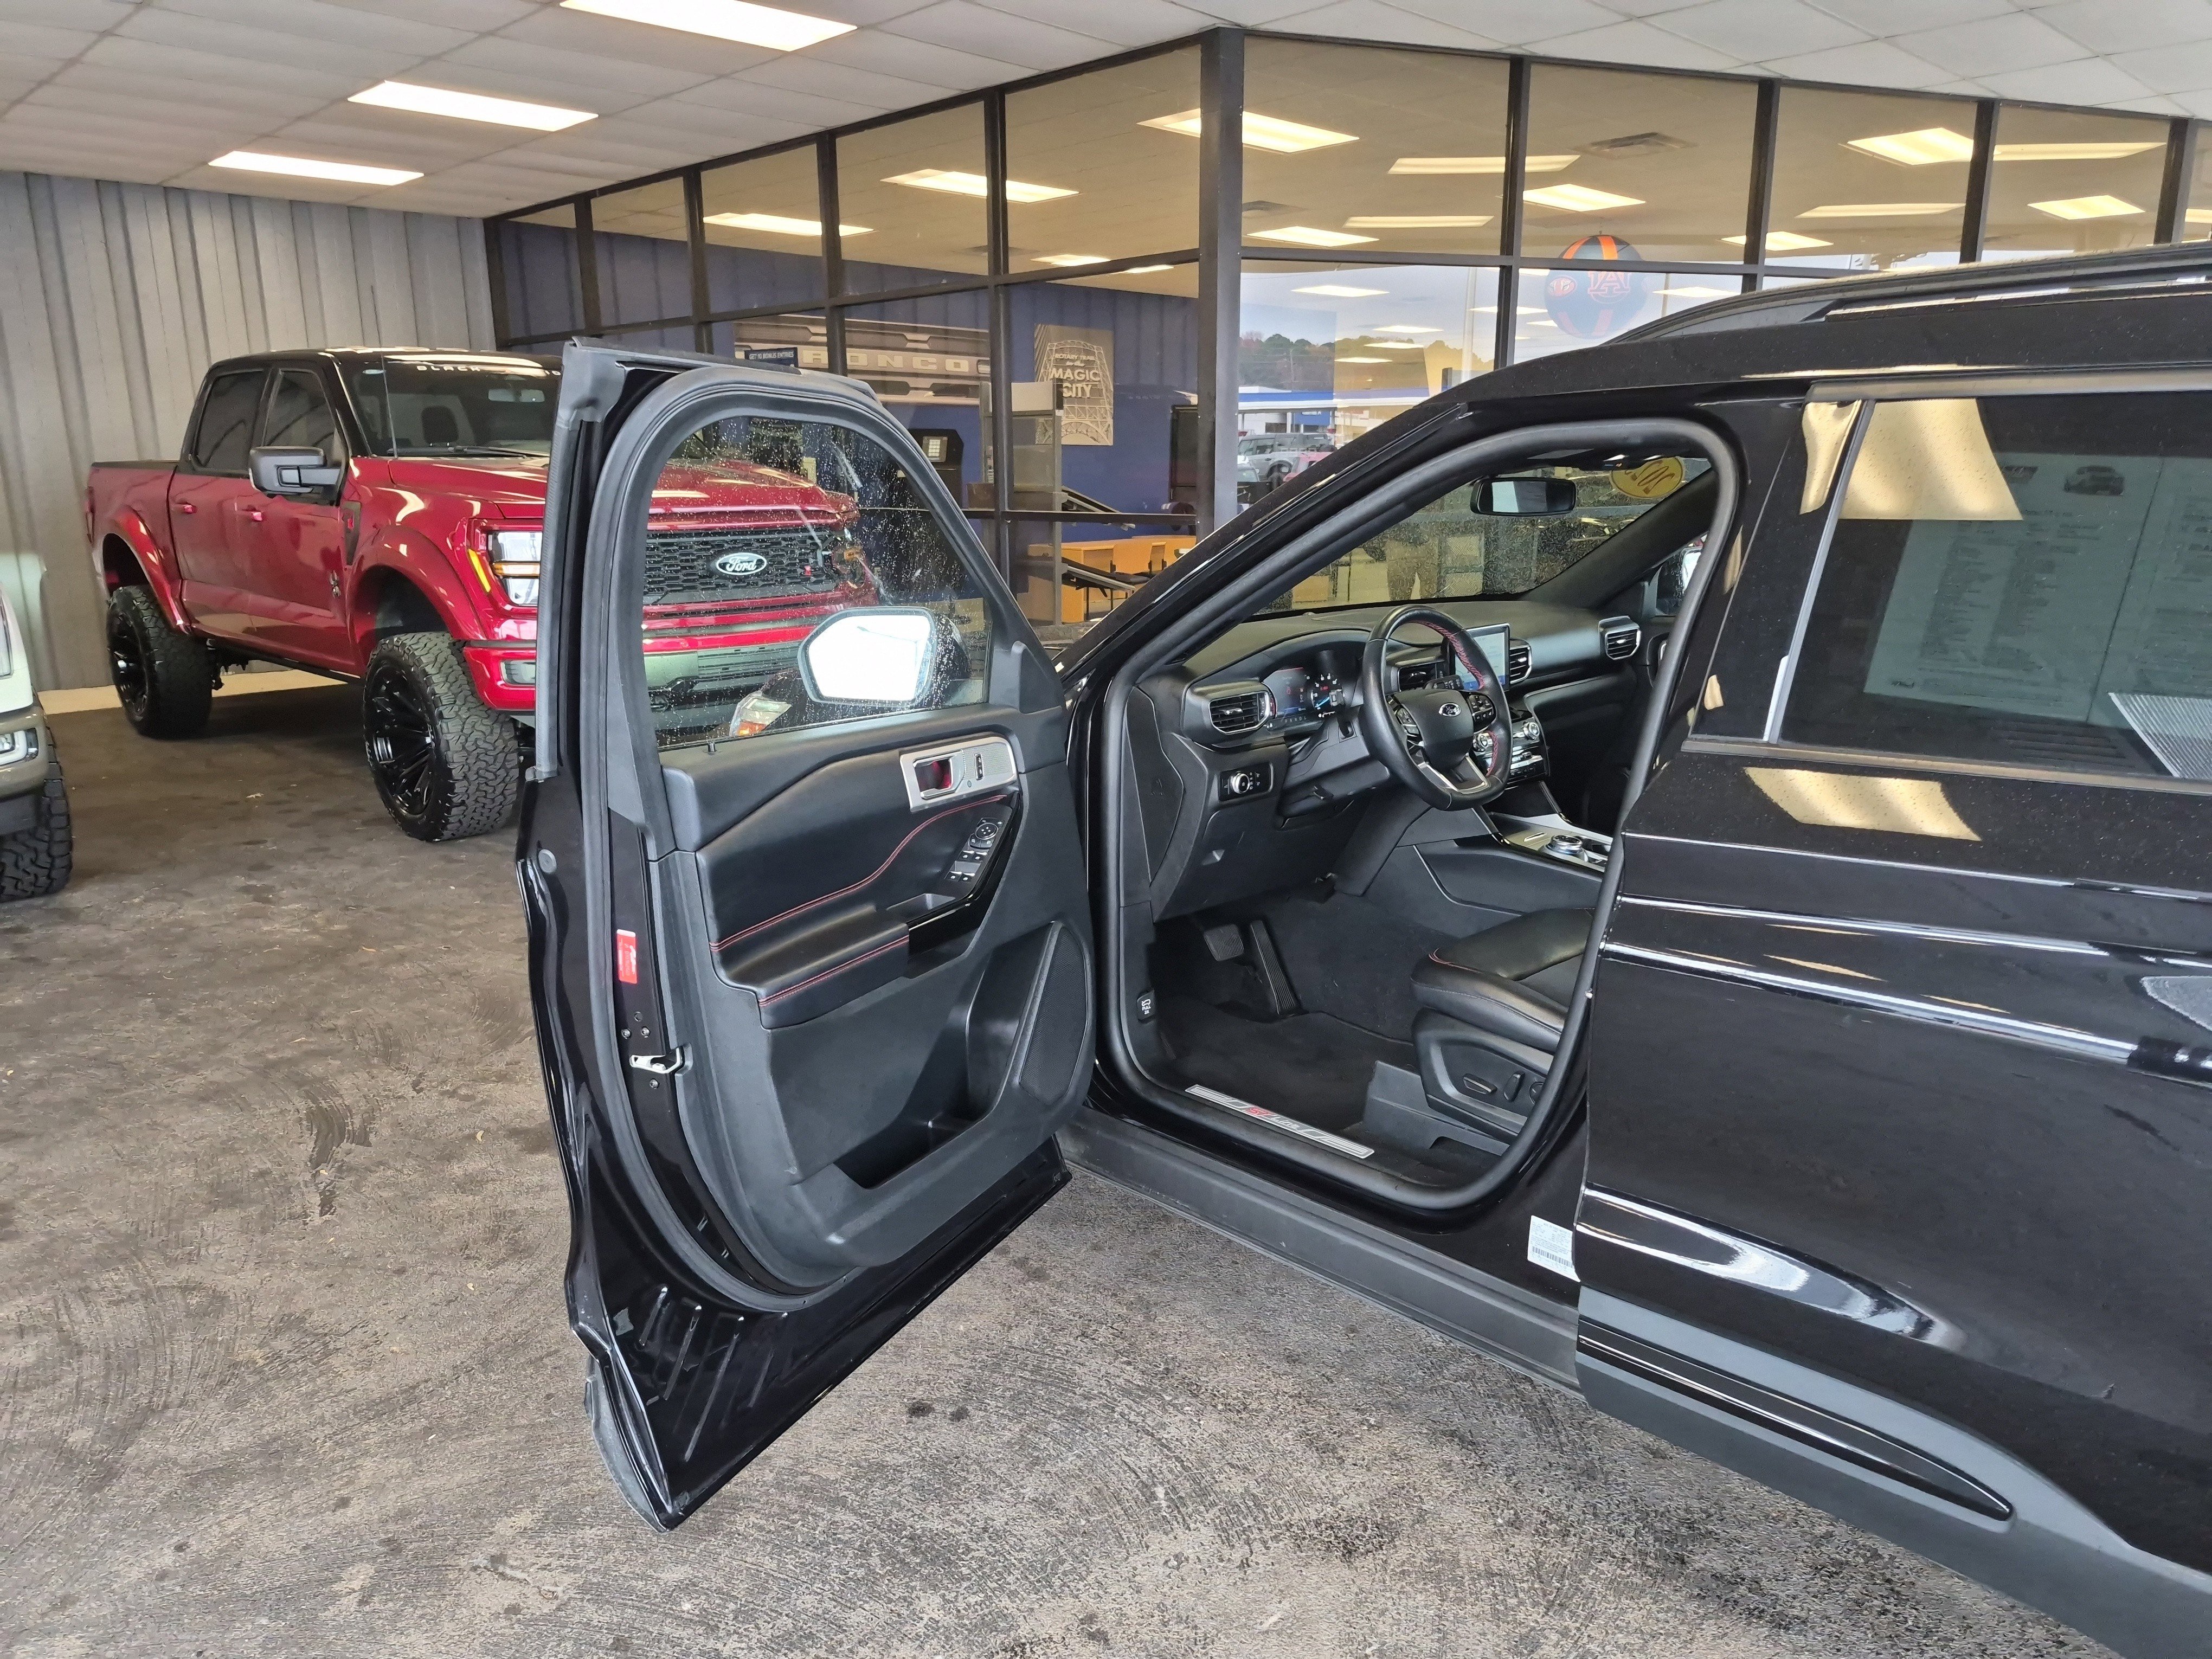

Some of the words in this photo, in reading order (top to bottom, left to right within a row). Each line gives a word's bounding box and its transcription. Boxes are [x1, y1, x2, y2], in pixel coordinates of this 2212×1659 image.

[1049, 368, 1101, 381] MAGIC
[1063, 383, 1092, 398] CITY
[725, 556, 757, 572] Ford
